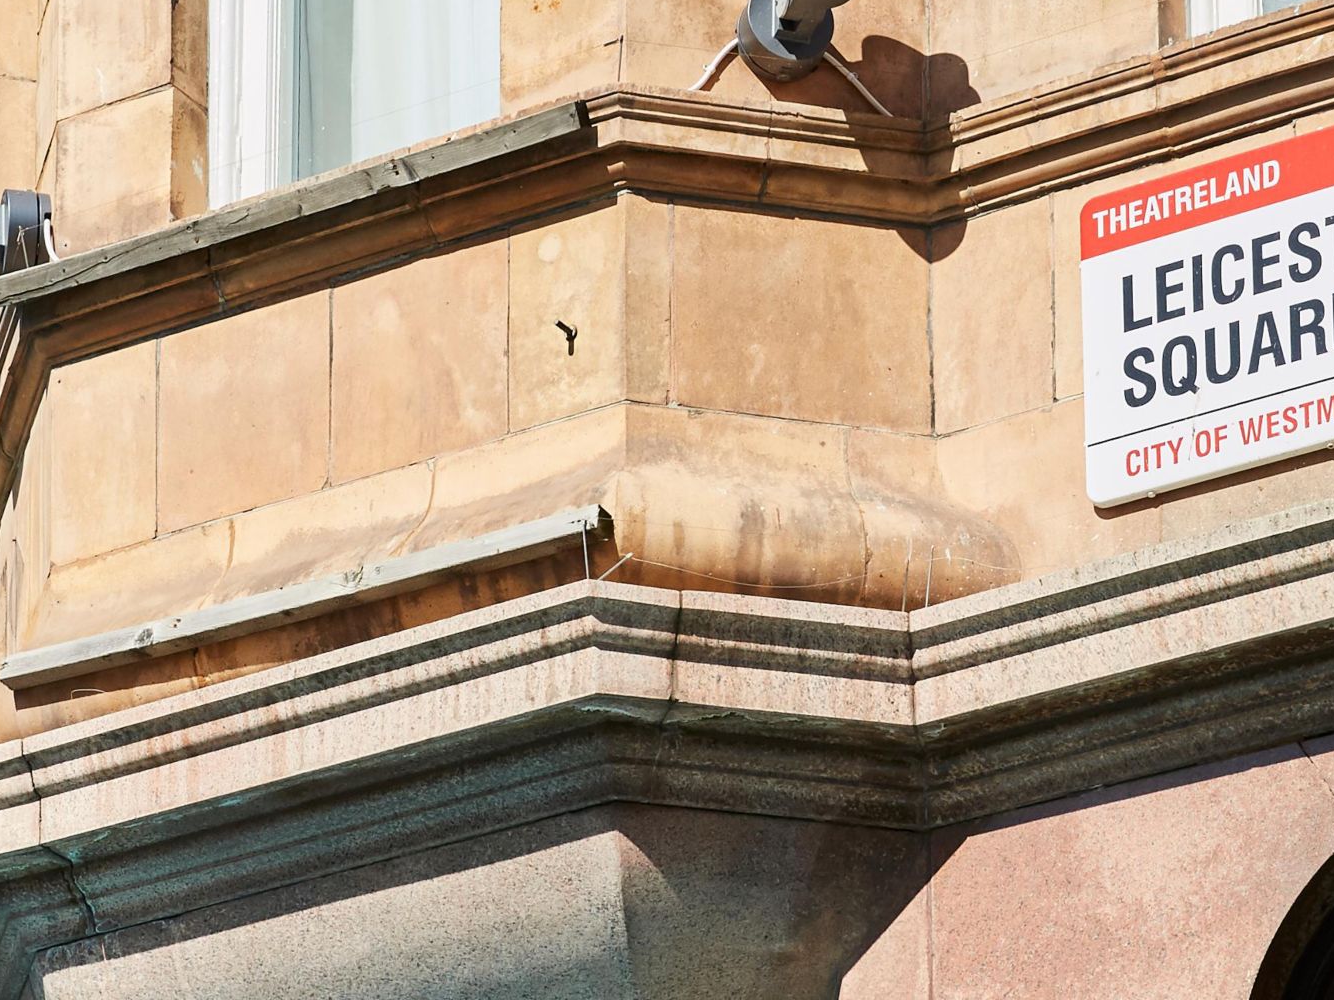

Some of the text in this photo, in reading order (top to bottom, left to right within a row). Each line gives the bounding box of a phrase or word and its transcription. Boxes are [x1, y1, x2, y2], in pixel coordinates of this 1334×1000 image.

[1093, 159, 1280, 239] THEATRELAND
[1126, 437, 1184, 477] CITY
[1195, 425, 1228, 458] OF
